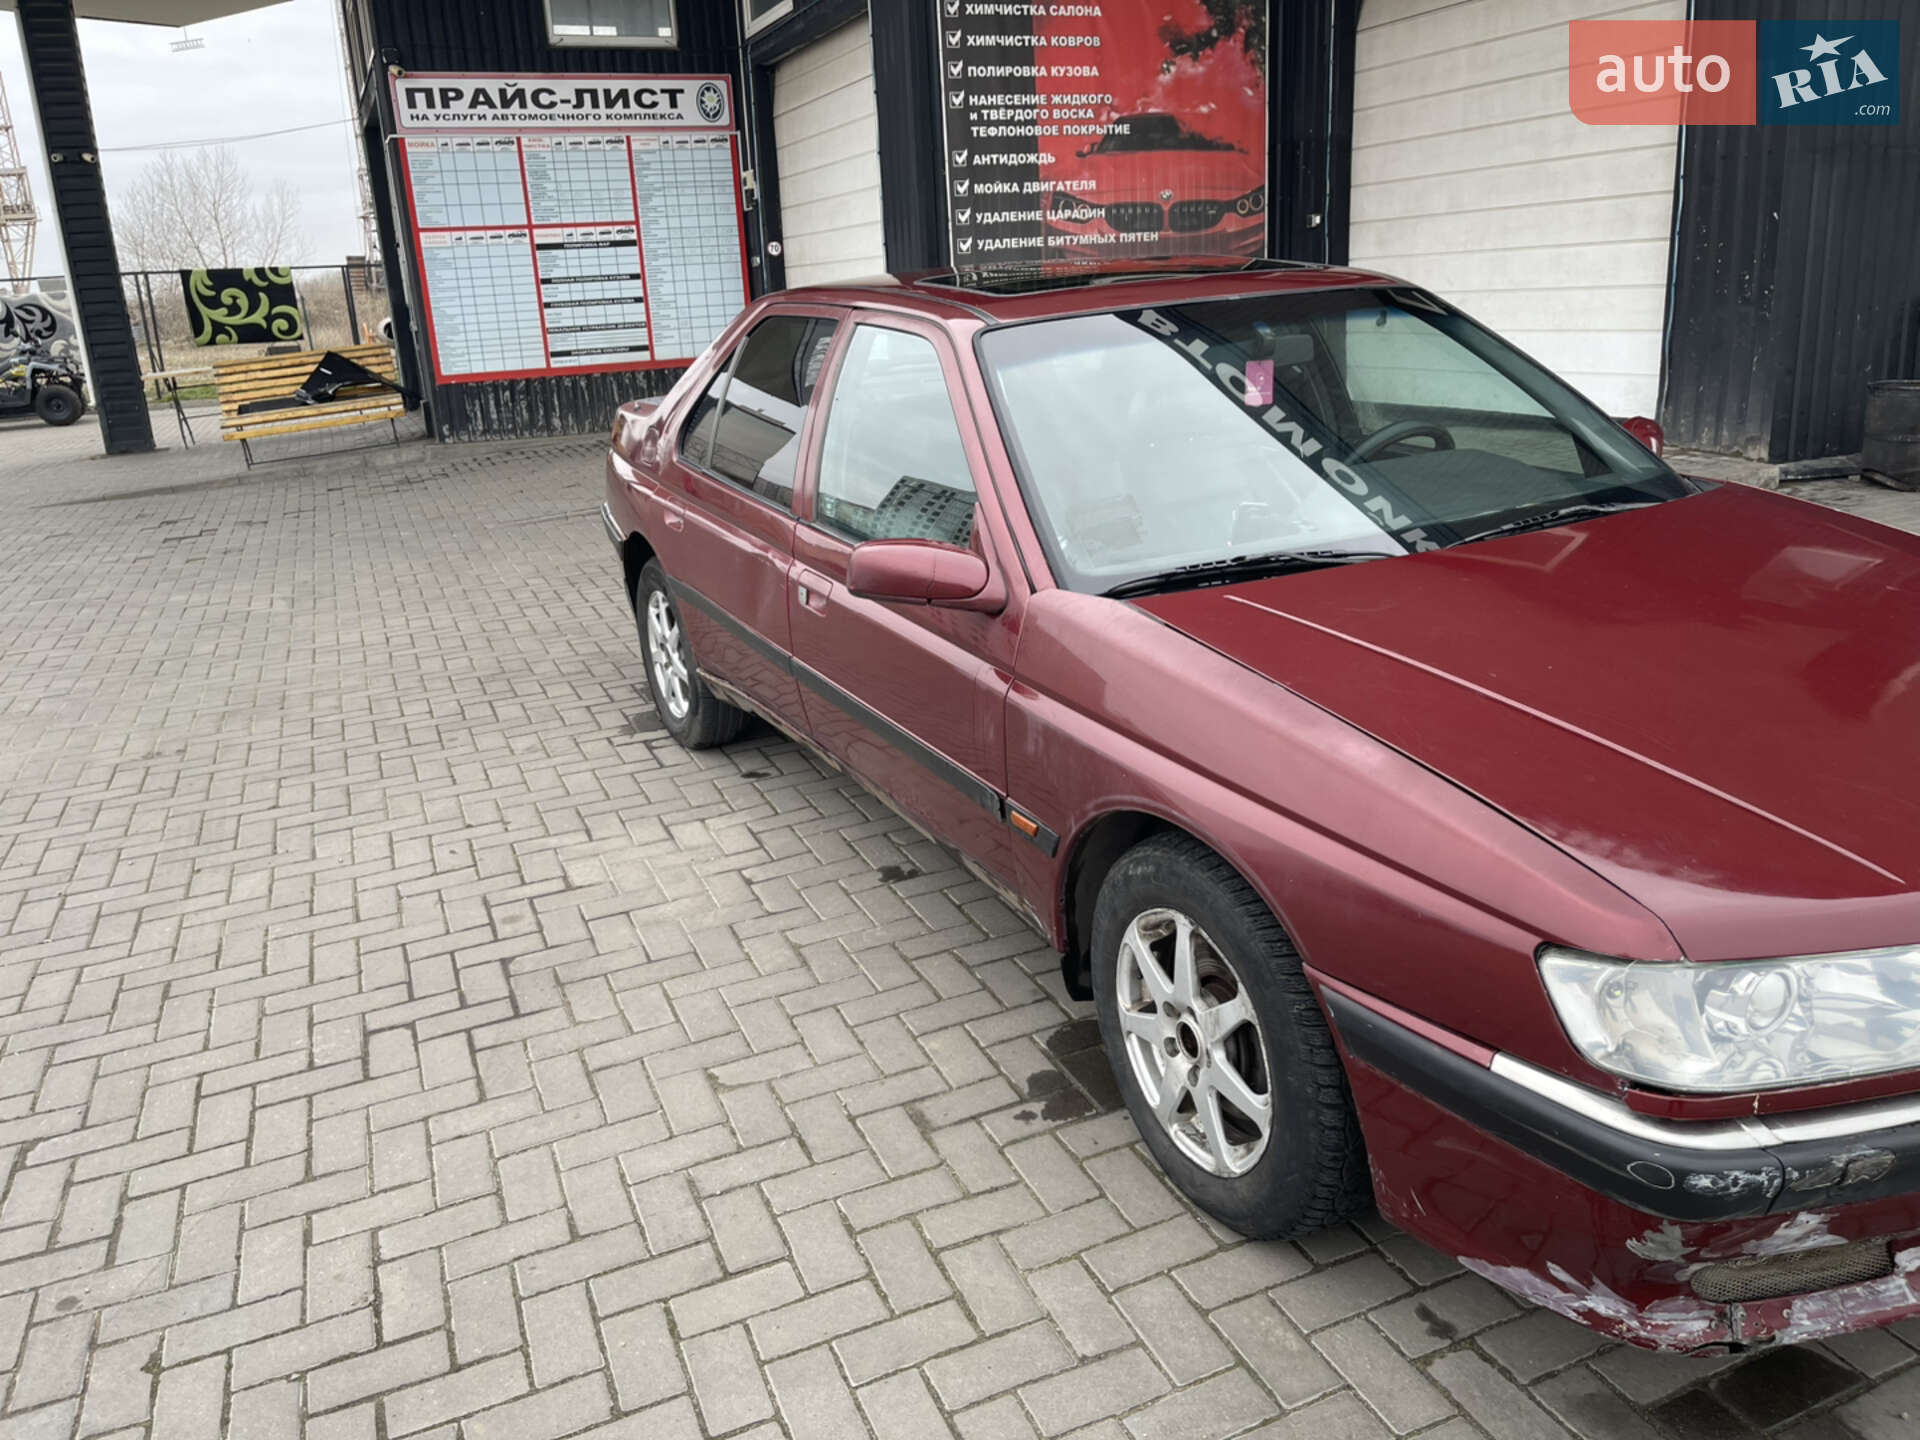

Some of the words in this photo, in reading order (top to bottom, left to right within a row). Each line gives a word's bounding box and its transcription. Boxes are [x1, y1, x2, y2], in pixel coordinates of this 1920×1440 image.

[965, 3, 1046, 16] ХИМЧИСТКА
[1049, 5, 1102, 17] САЛОНА
[967, 35, 1048, 47] ХИМЧИСТКА
[1051, 36, 1101, 47] КОВРОВ
[968, 66, 1048, 78] ПОЛИРОВКА
[1051, 66, 1100, 77] КУЗОВА
[405, 82, 684, 109] ПРАЙС-ЛИСТ
[969, 94, 1047, 106] НАНЕСЕНИЕ
[1051, 94, 1113, 106] ЖИДКОГО
[410, 113, 430, 121] НА
[434, 113, 487, 121] УСЛУГИ
[491, 113, 602, 121] АВТОМОЕЧНОГО
[606, 113, 684, 121] КОМПЛЕКСА
[969, 112, 978, 121] и
[1053, 108, 1094, 119] ВОСКА
[971, 125, 1059, 137] ТЕФЛОНОВОЕ
[1063, 124, 1131, 135] ПОКРЫТИЕ
[973, 153, 1056, 165] АНТИДОЖДЬ
[974, 181, 1020, 194] МОЙКА
[1023, 180, 1097, 194] ДВИГАТЕЛЯ
[976, 210, 1044, 224] УДАЛЕНИЕ
[1047, 208, 1106, 221] ЦАРАПИН
[977, 237, 1045, 251] УДАЛЕНИЕ
[1048, 235, 1116, 248] БИТУМНЫХ
[1119, 232, 1159, 244] ПЯТЕН
